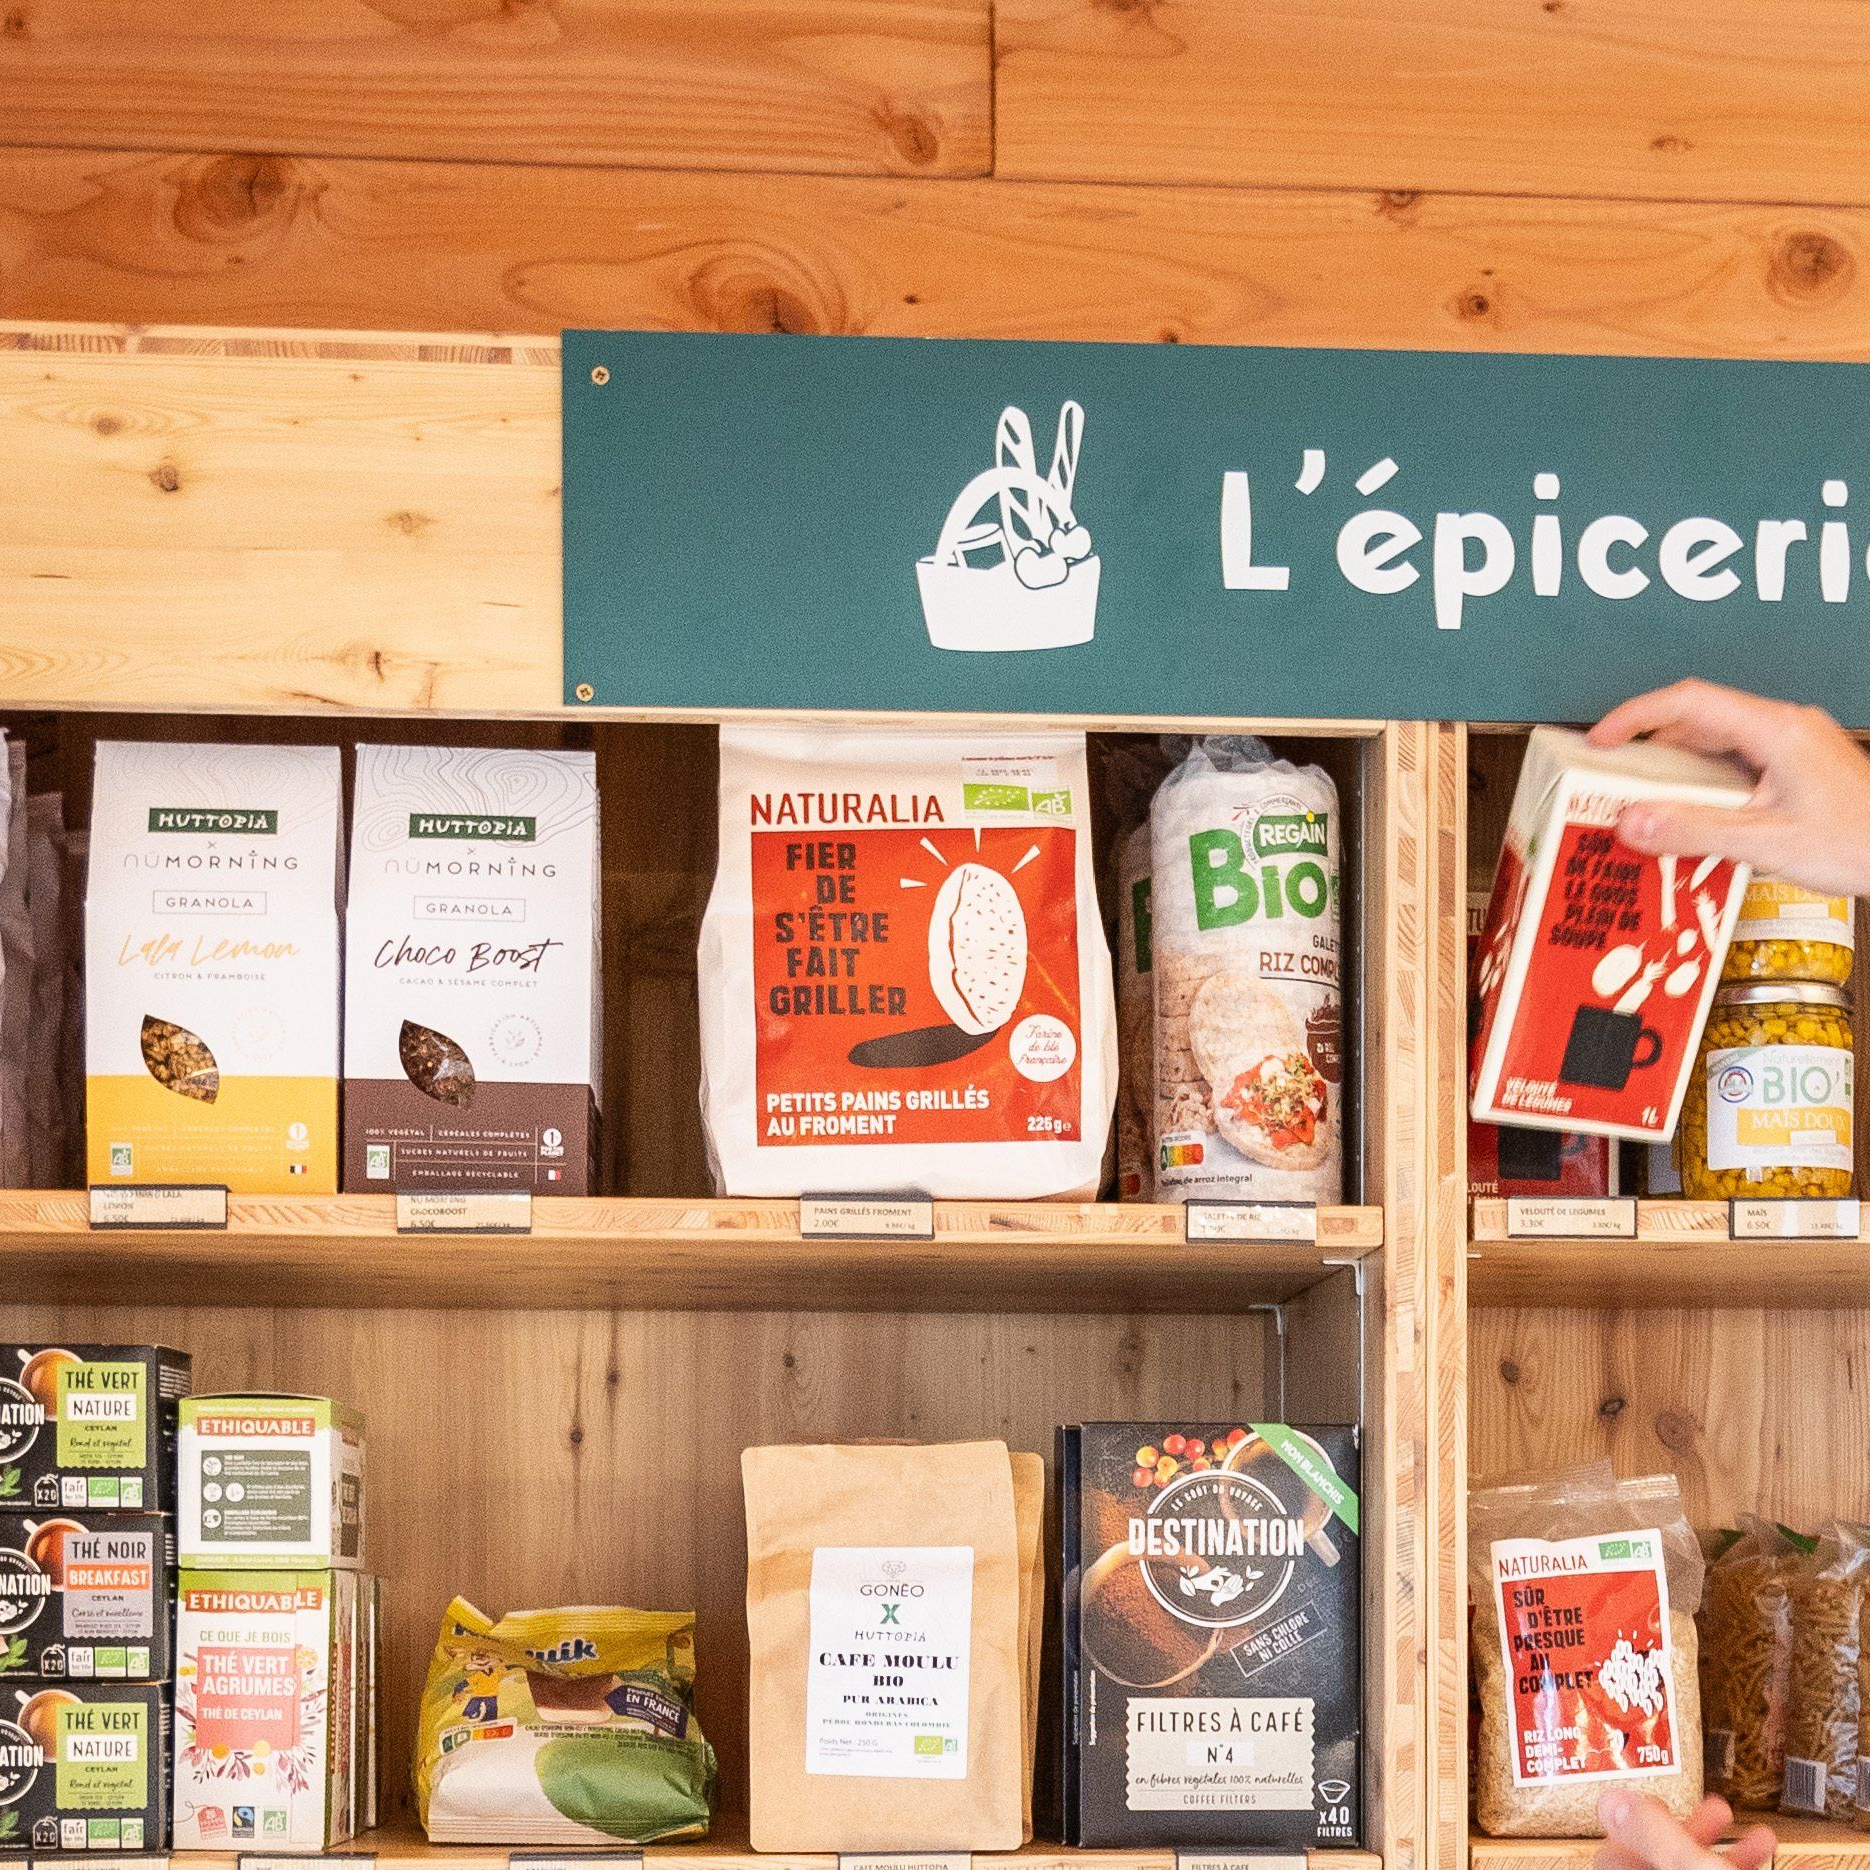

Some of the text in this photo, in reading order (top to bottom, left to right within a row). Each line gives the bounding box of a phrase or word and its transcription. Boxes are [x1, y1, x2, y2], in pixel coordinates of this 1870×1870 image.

[750, 793, 944, 826] NATURALIA
[159, 814, 268, 829] HUTTOPIA
[1259, 819, 1326, 848] REGAIN
[786, 842, 857, 872] FIER
[815, 874, 856, 905] DE
[1189, 828, 1328, 932] Bio
[166, 897, 254, 908] GRANOLA
[775, 905, 889, 943] S'ÊTRE
[118, 933, 301, 966] Lala Lemon
[374, 935, 564, 973] Choco Boost
[786, 947, 860, 978] FAIT
[1259, 951, 1294, 972] RIZ
[154, 972, 266, 981] CITRON FRAMBOISE
[769, 984, 906, 1017] GRILLER
[766, 1086, 989, 1112] PETITS PAINS GRILLÉS
[767, 1115, 896, 1136] AU FROMENT
[1753, 1108, 1798, 1129] MAÏS
[813, 1204, 912, 1217] PAINS GRILLÉS FROMENT
[813, 1218, 839, 1228] 2.00€
[67, 1368, 139, 1389] THÉ VERT
[73, 1400, 130, 1416] NATURE
[201, 1419, 310, 1434] ETHIQUABLE
[1279, 1438, 1346, 1506] NON BLANCHIS
[1128, 1516, 1304, 1558] DESTINATION
[73, 1538, 146, 1559] THÉ NOIR
[1498, 1554, 1589, 1577] NATURALIA
[69, 1569, 147, 1585] BREAKFAST
[200, 1630, 291, 1643] CE QUE JE BOIS
[855, 1631, 926, 1642] HUTTOPIA
[204, 1651, 288, 1674] THÉ VERT
[820, 1652, 958, 1669] CAFE MOULU
[202, 1676, 295, 1696] AGRUMES
[873, 1675, 904, 1687] BIO
[626, 1694, 680, 1723] EN FRANCE
[844, 1695, 938, 1706] PUR ARABICA
[1137, 1707, 1303, 1732] FILTRES À CAFÉ
[1638, 1744, 1669, 1766] 750g
[1255, 1773, 1303, 1784] naturelles
[1183, 1795, 1256, 1805] COFFEE FILTERS
[1319, 1807, 1350, 1824] x40
[1317, 1826, 1353, 1837] FILTRES
